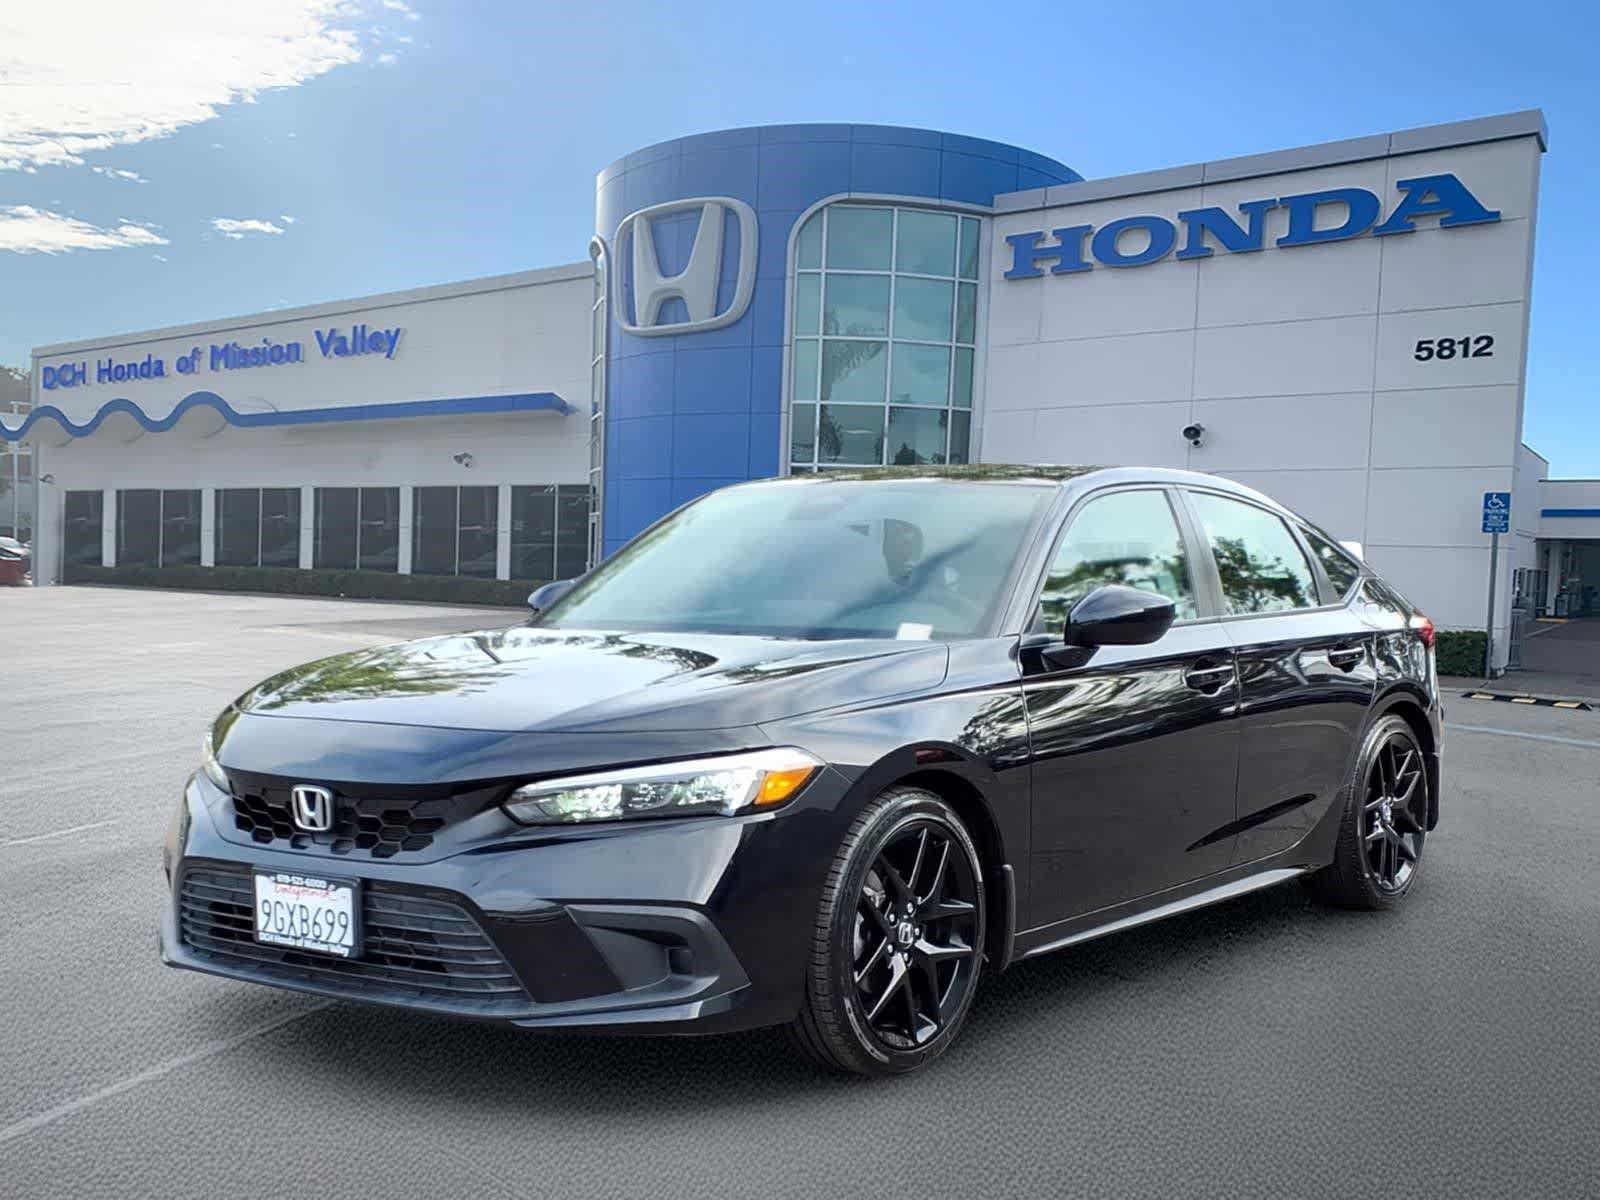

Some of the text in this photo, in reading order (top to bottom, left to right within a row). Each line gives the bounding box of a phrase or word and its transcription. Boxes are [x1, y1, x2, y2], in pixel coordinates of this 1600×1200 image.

[1004, 173, 1501, 280] HONDA
[42, 324, 401, 390] DCH Honda of Mission Valley
[1414, 335, 1495, 362] 5812
[261, 899, 349, 943] 9GXB699
